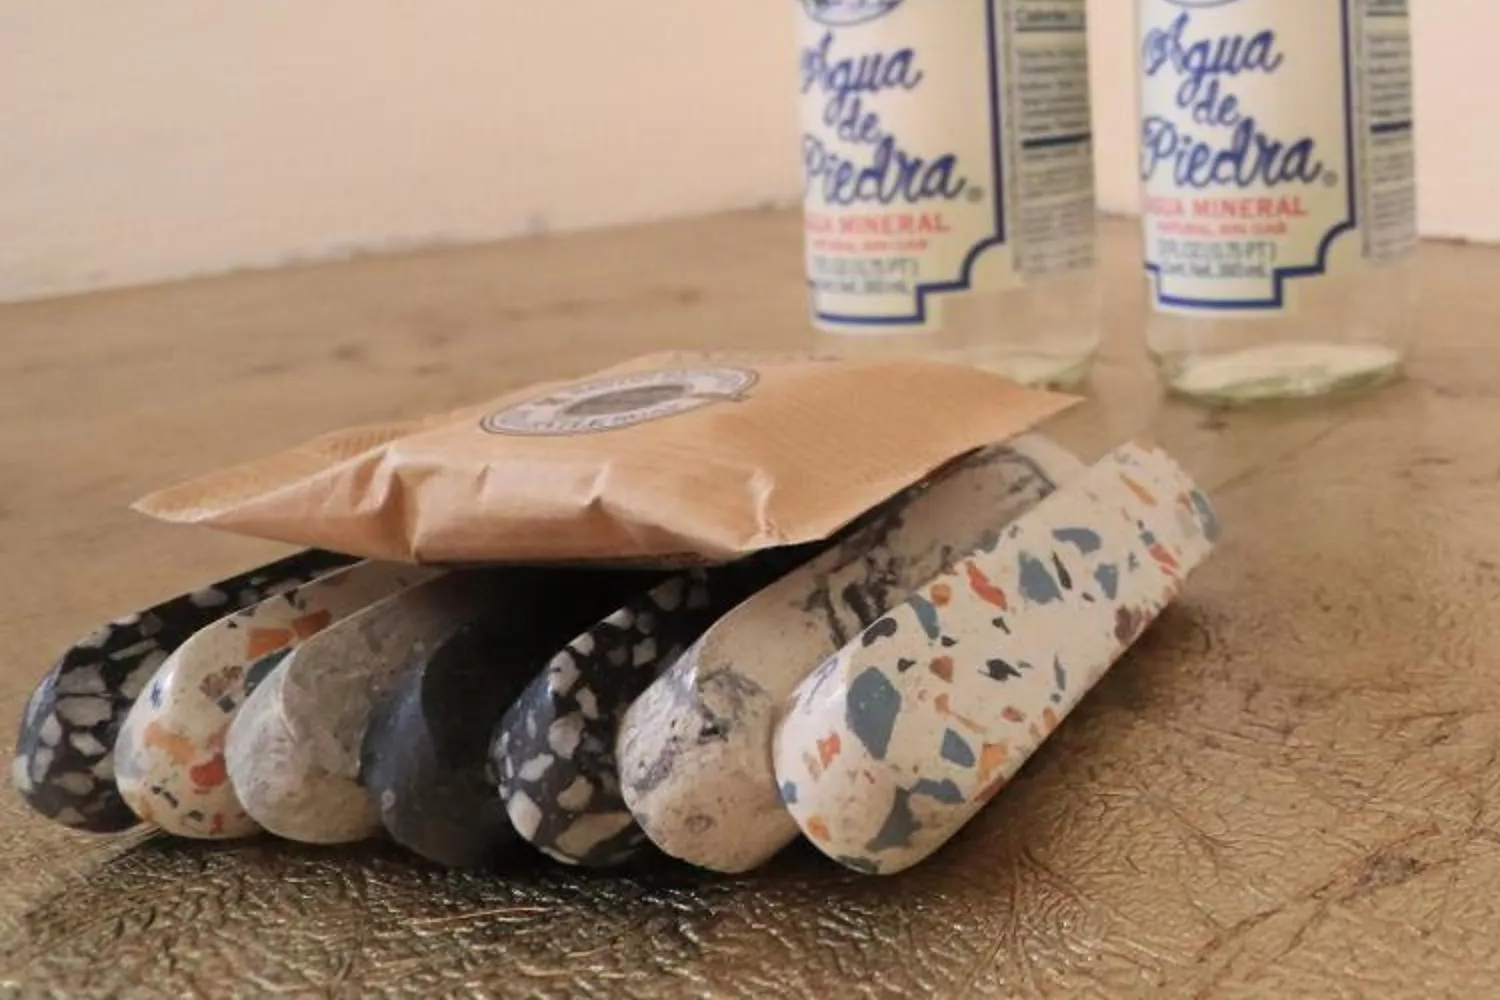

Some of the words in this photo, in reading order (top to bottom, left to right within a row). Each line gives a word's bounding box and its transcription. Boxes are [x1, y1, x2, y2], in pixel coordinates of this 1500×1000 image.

[800, 28, 924, 126] Agua
[1141, 11, 1285, 108] Agua
[838, 97, 881, 145] de
[1192, 77, 1240, 126] de
[803, 133, 967, 206] Piedra
[1141, 114, 1323, 189] Piedra
[838, 211, 952, 234] MINERAL
[1191, 194, 1309, 218] MINERAL
